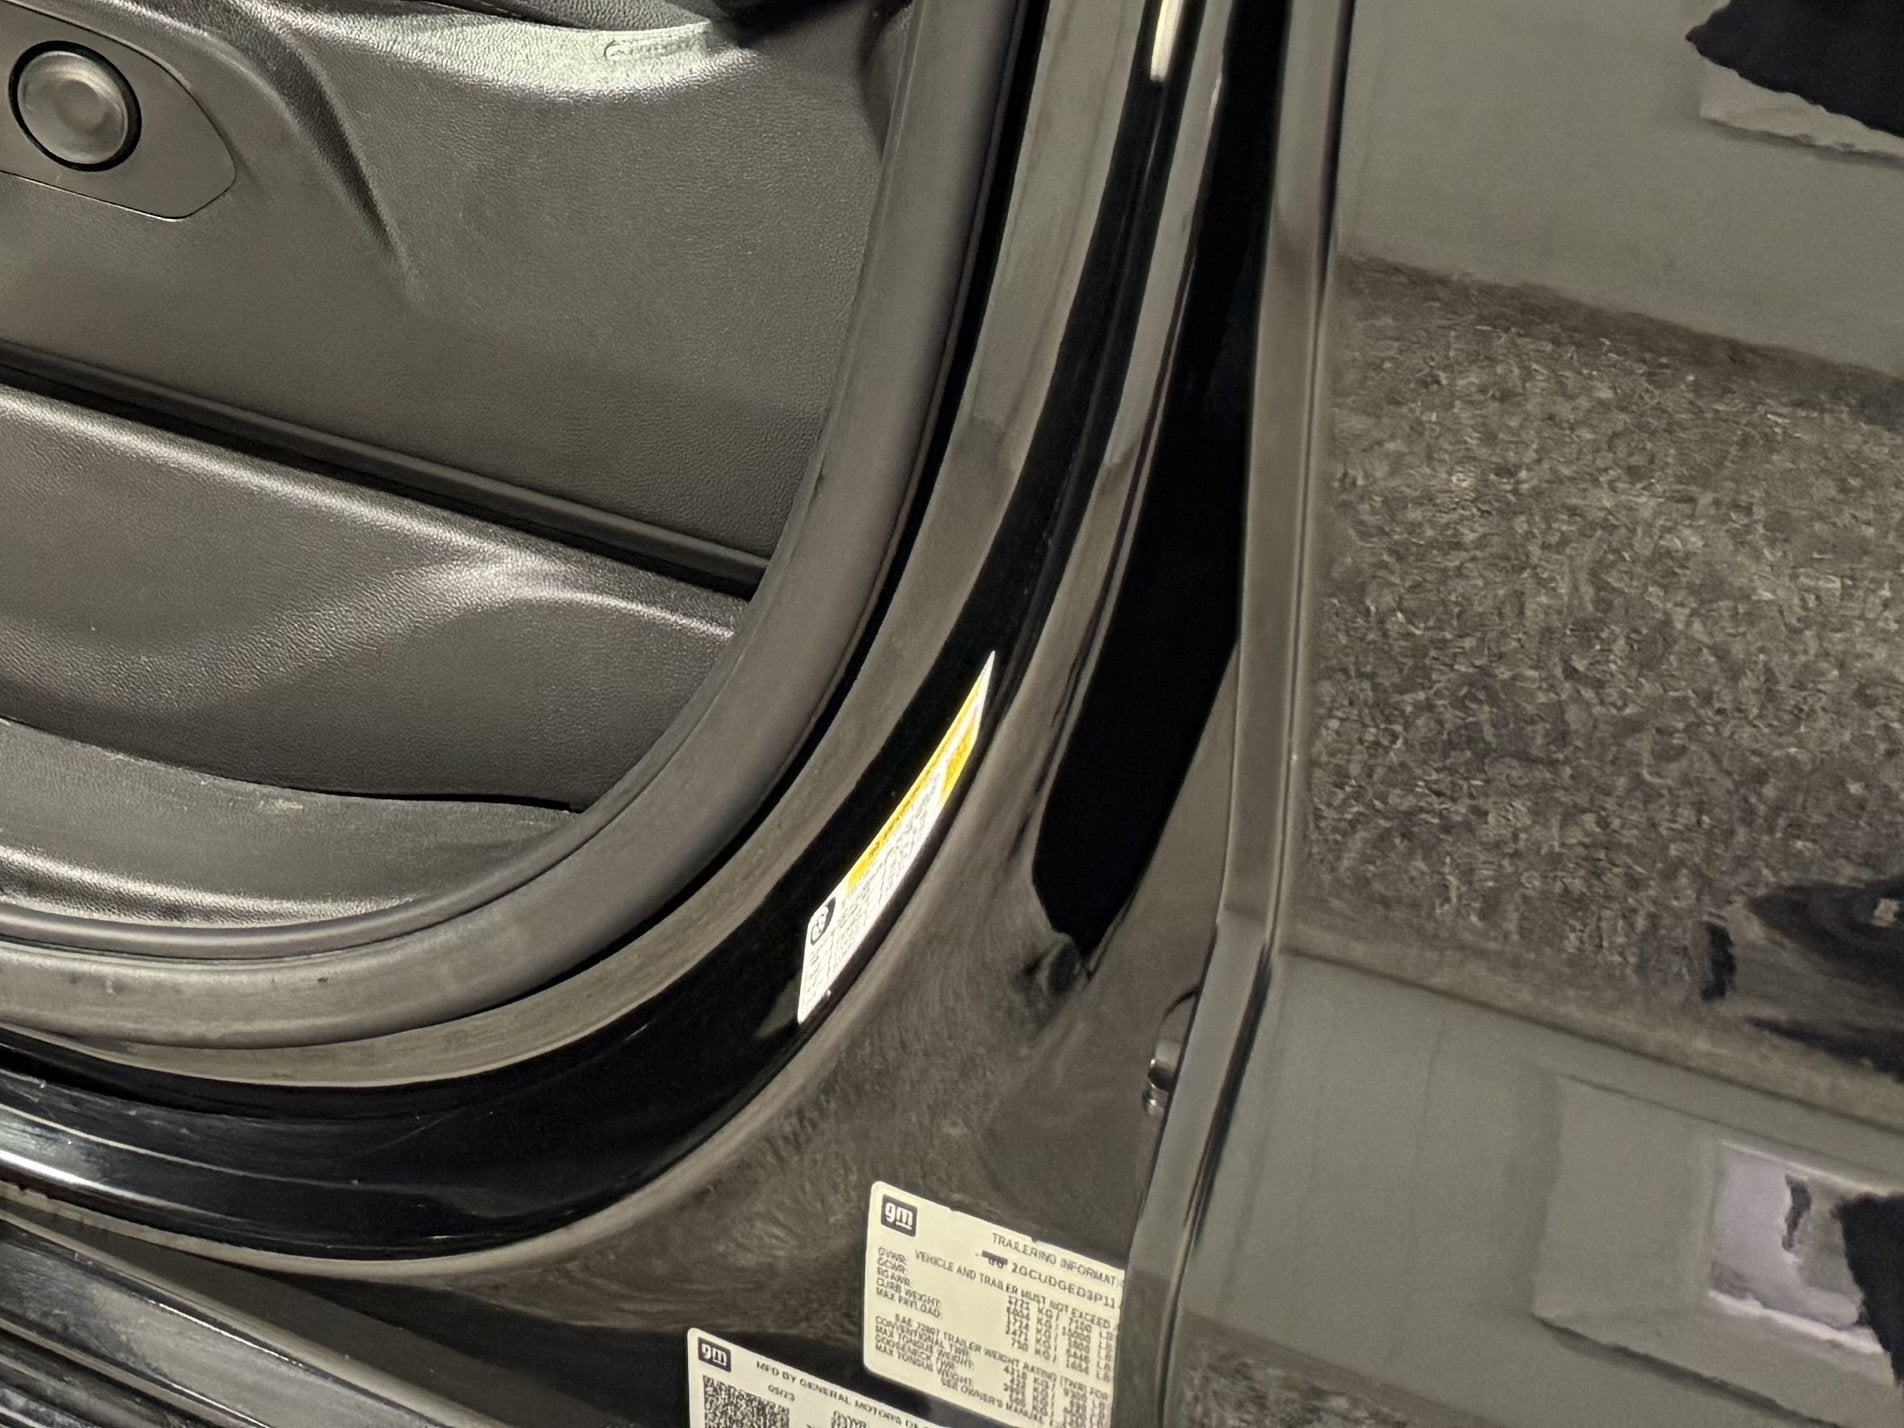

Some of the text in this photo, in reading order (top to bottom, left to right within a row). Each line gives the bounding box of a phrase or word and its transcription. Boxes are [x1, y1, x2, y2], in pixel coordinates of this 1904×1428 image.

[884, 1201, 913, 1230] gm
[992, 1233, 1056, 1265] TRAILERING
[915, 1250, 953, 1272] VEHICLE
[956, 1265, 975, 1279] AND
[979, 1273, 1017, 1295] TRAILER
[701, 1343, 727, 1365] gm
[799, 1377, 851, 1405] GENERAL
